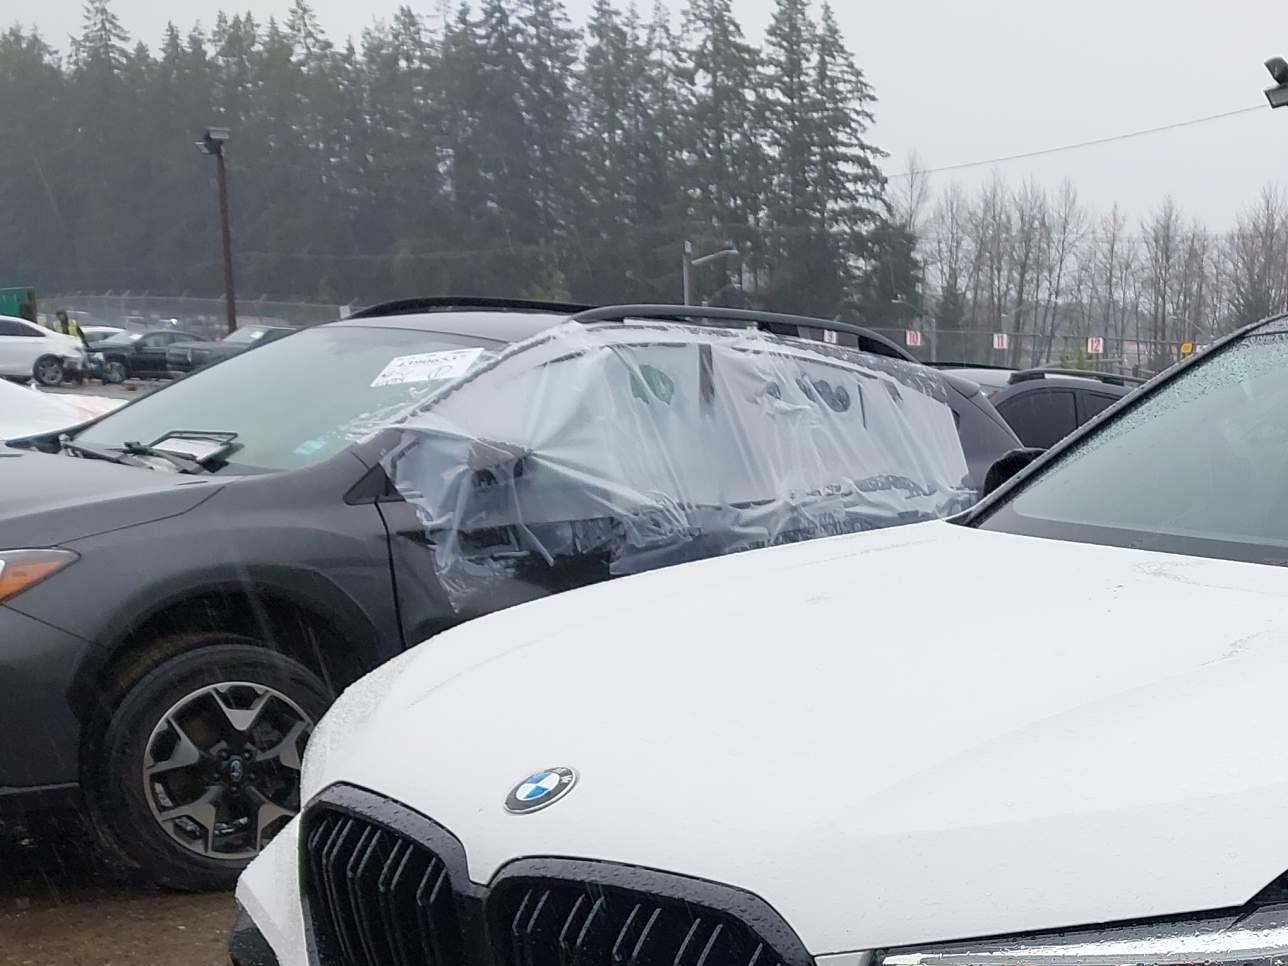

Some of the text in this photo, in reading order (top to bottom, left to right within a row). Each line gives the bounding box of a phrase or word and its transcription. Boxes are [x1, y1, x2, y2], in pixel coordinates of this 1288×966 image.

[908, 331, 919, 345] 10
[996, 335, 1006, 348] 11
[1089, 338, 1102, 353] 12
